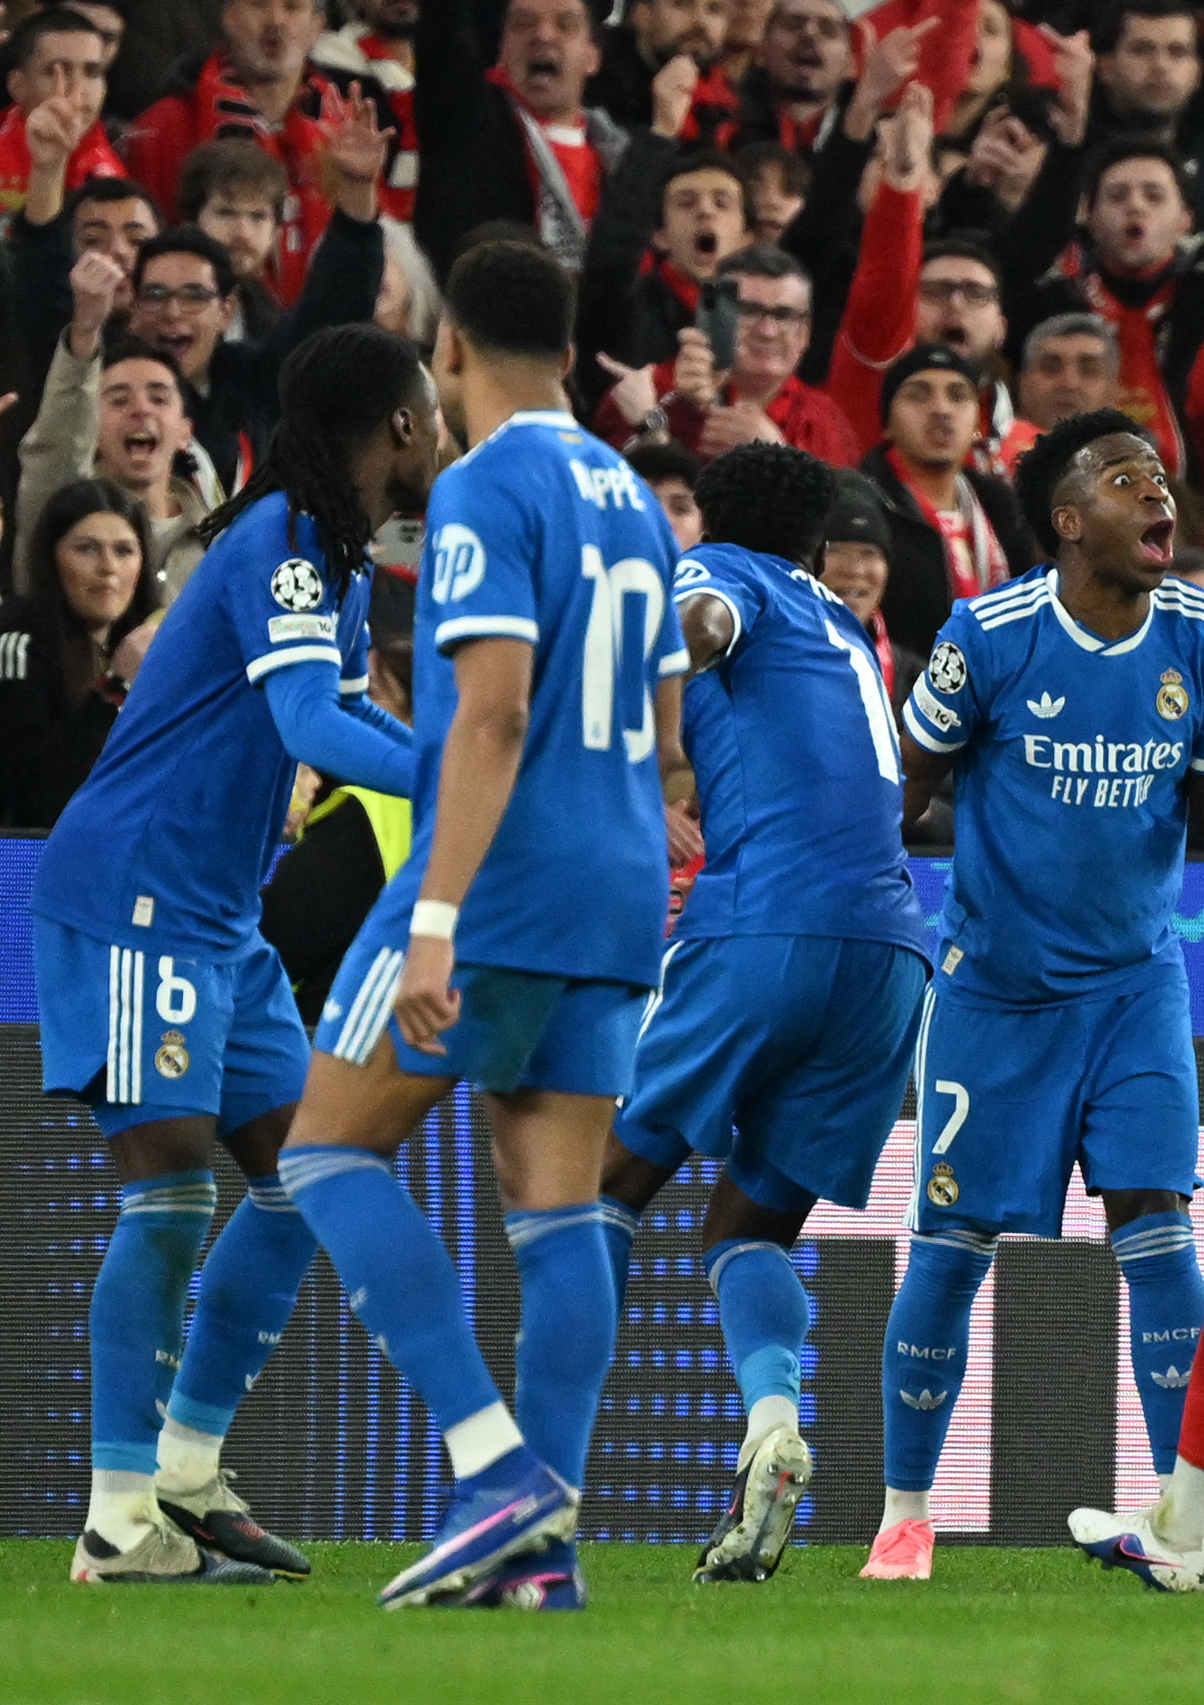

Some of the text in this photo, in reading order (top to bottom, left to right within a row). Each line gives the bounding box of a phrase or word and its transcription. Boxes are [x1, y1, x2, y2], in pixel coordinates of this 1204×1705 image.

[581, 543, 664, 764] 10
[825, 619, 899, 785] 1
[1023, 734, 1184, 773] Emirates
[1051, 775, 1090, 805] FLY
[156, 955, 197, 1025] 6
[932, 1079, 969, 1154] 7
[897, 1341, 957, 1360] RMCF
[1142, 1327, 1201, 1344] RMCF
